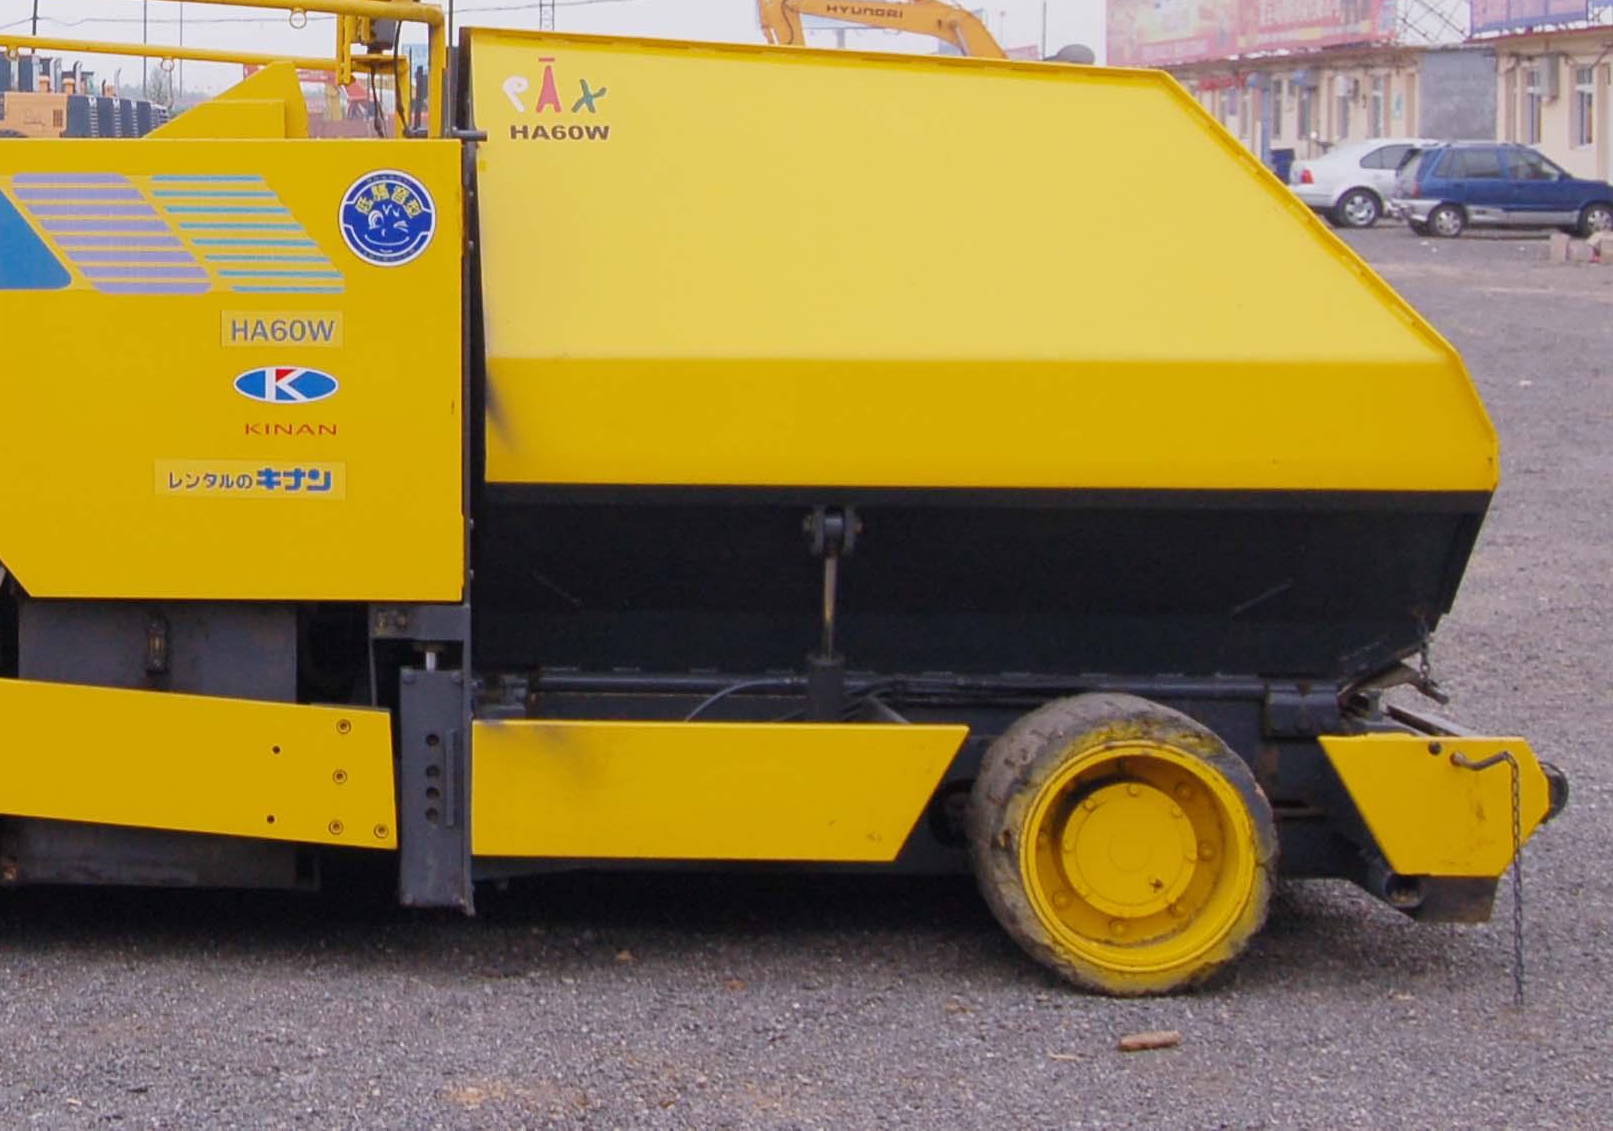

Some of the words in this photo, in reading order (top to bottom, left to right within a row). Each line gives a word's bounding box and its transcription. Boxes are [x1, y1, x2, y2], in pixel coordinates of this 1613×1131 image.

[510, 125, 610, 140] HA60W
[231, 319, 335, 342] HA60W
[245, 423, 337, 436] KINAN
